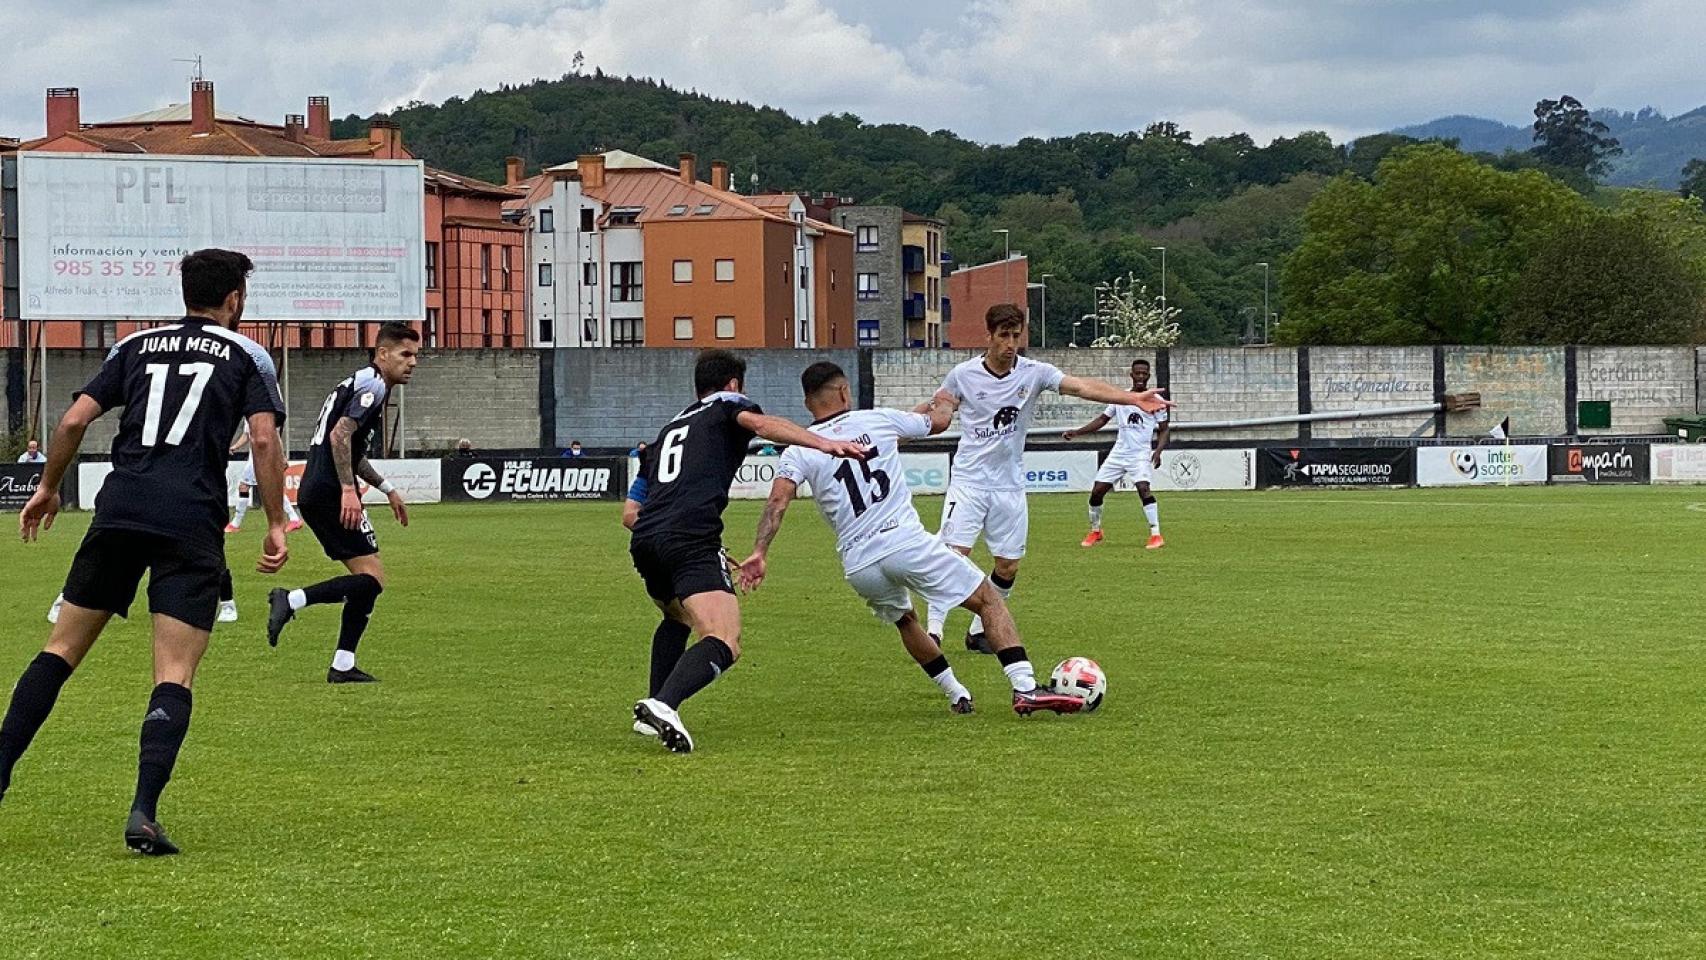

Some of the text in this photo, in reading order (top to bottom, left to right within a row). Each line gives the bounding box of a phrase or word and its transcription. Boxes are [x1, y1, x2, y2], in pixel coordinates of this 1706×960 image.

[115, 166, 187, 204] PFL
[53, 243, 133, 257] información
[138, 248, 147, 257] y
[53, 260, 93, 276] 985
[100, 261, 125, 276] 35
[131, 261, 156, 276] 52
[138, 336, 231, 361] JUAN MERA
[141, 362, 215, 447] 17
[657, 424, 690, 484] 6
[1487, 449, 1516, 463] inter
[504, 461, 533, 469] VIAJES
[1480, 463, 1524, 476] soccer
[500, 468, 611, 493] ECUADOR
[833, 446, 891, 518] 15
[904, 468, 943, 487] se
[1025, 469, 1068, 482] ersa
[947, 501, 957, 519] 7
